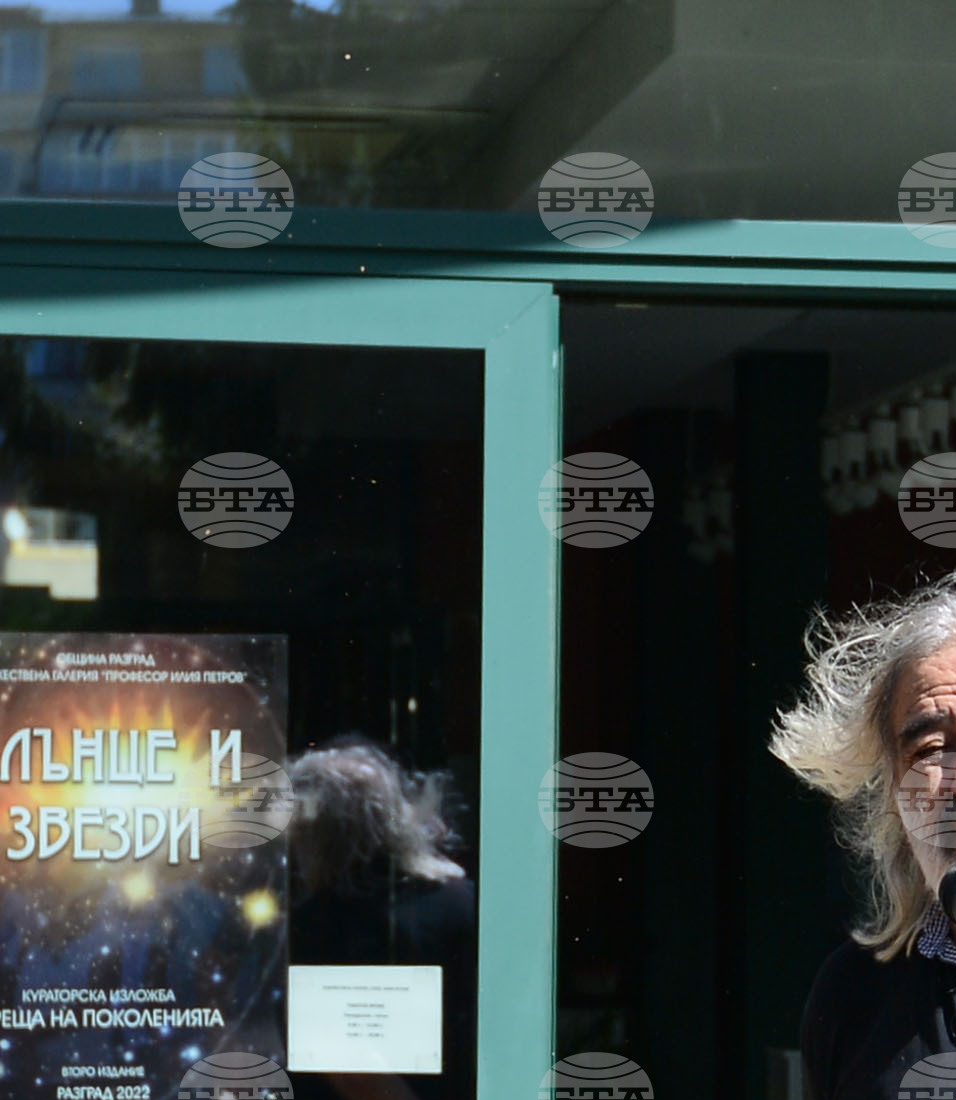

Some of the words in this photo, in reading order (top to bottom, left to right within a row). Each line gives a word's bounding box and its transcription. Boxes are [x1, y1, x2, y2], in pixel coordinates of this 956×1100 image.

[56, 653, 107, 667] ОБЩИНА
[108, 653, 155, 667] РАЗГРАД
[52, 669, 98, 682] ГАЛЕРИЯ
[170, 670, 200, 683] ИЛИЯ
[209, 729, 243, 787] И
[6, 806, 201, 865] ЗВЕЗДИ
[22, 988, 107, 1003] КУРАТОРСКА
[110, 988, 176, 1003] ИЗЛОЖБА
[0, 1008, 46, 1031] ЕЩА
[50, 1008, 78, 1029] НА
[82, 1008, 225, 1029] ПОКОЛЕНИЯТА
[61, 1066, 97, 1078] ВТОРО
[98, 1066, 145, 1079] ИЗДАНИЕ
[116, 1085, 151, 1100] 2022
